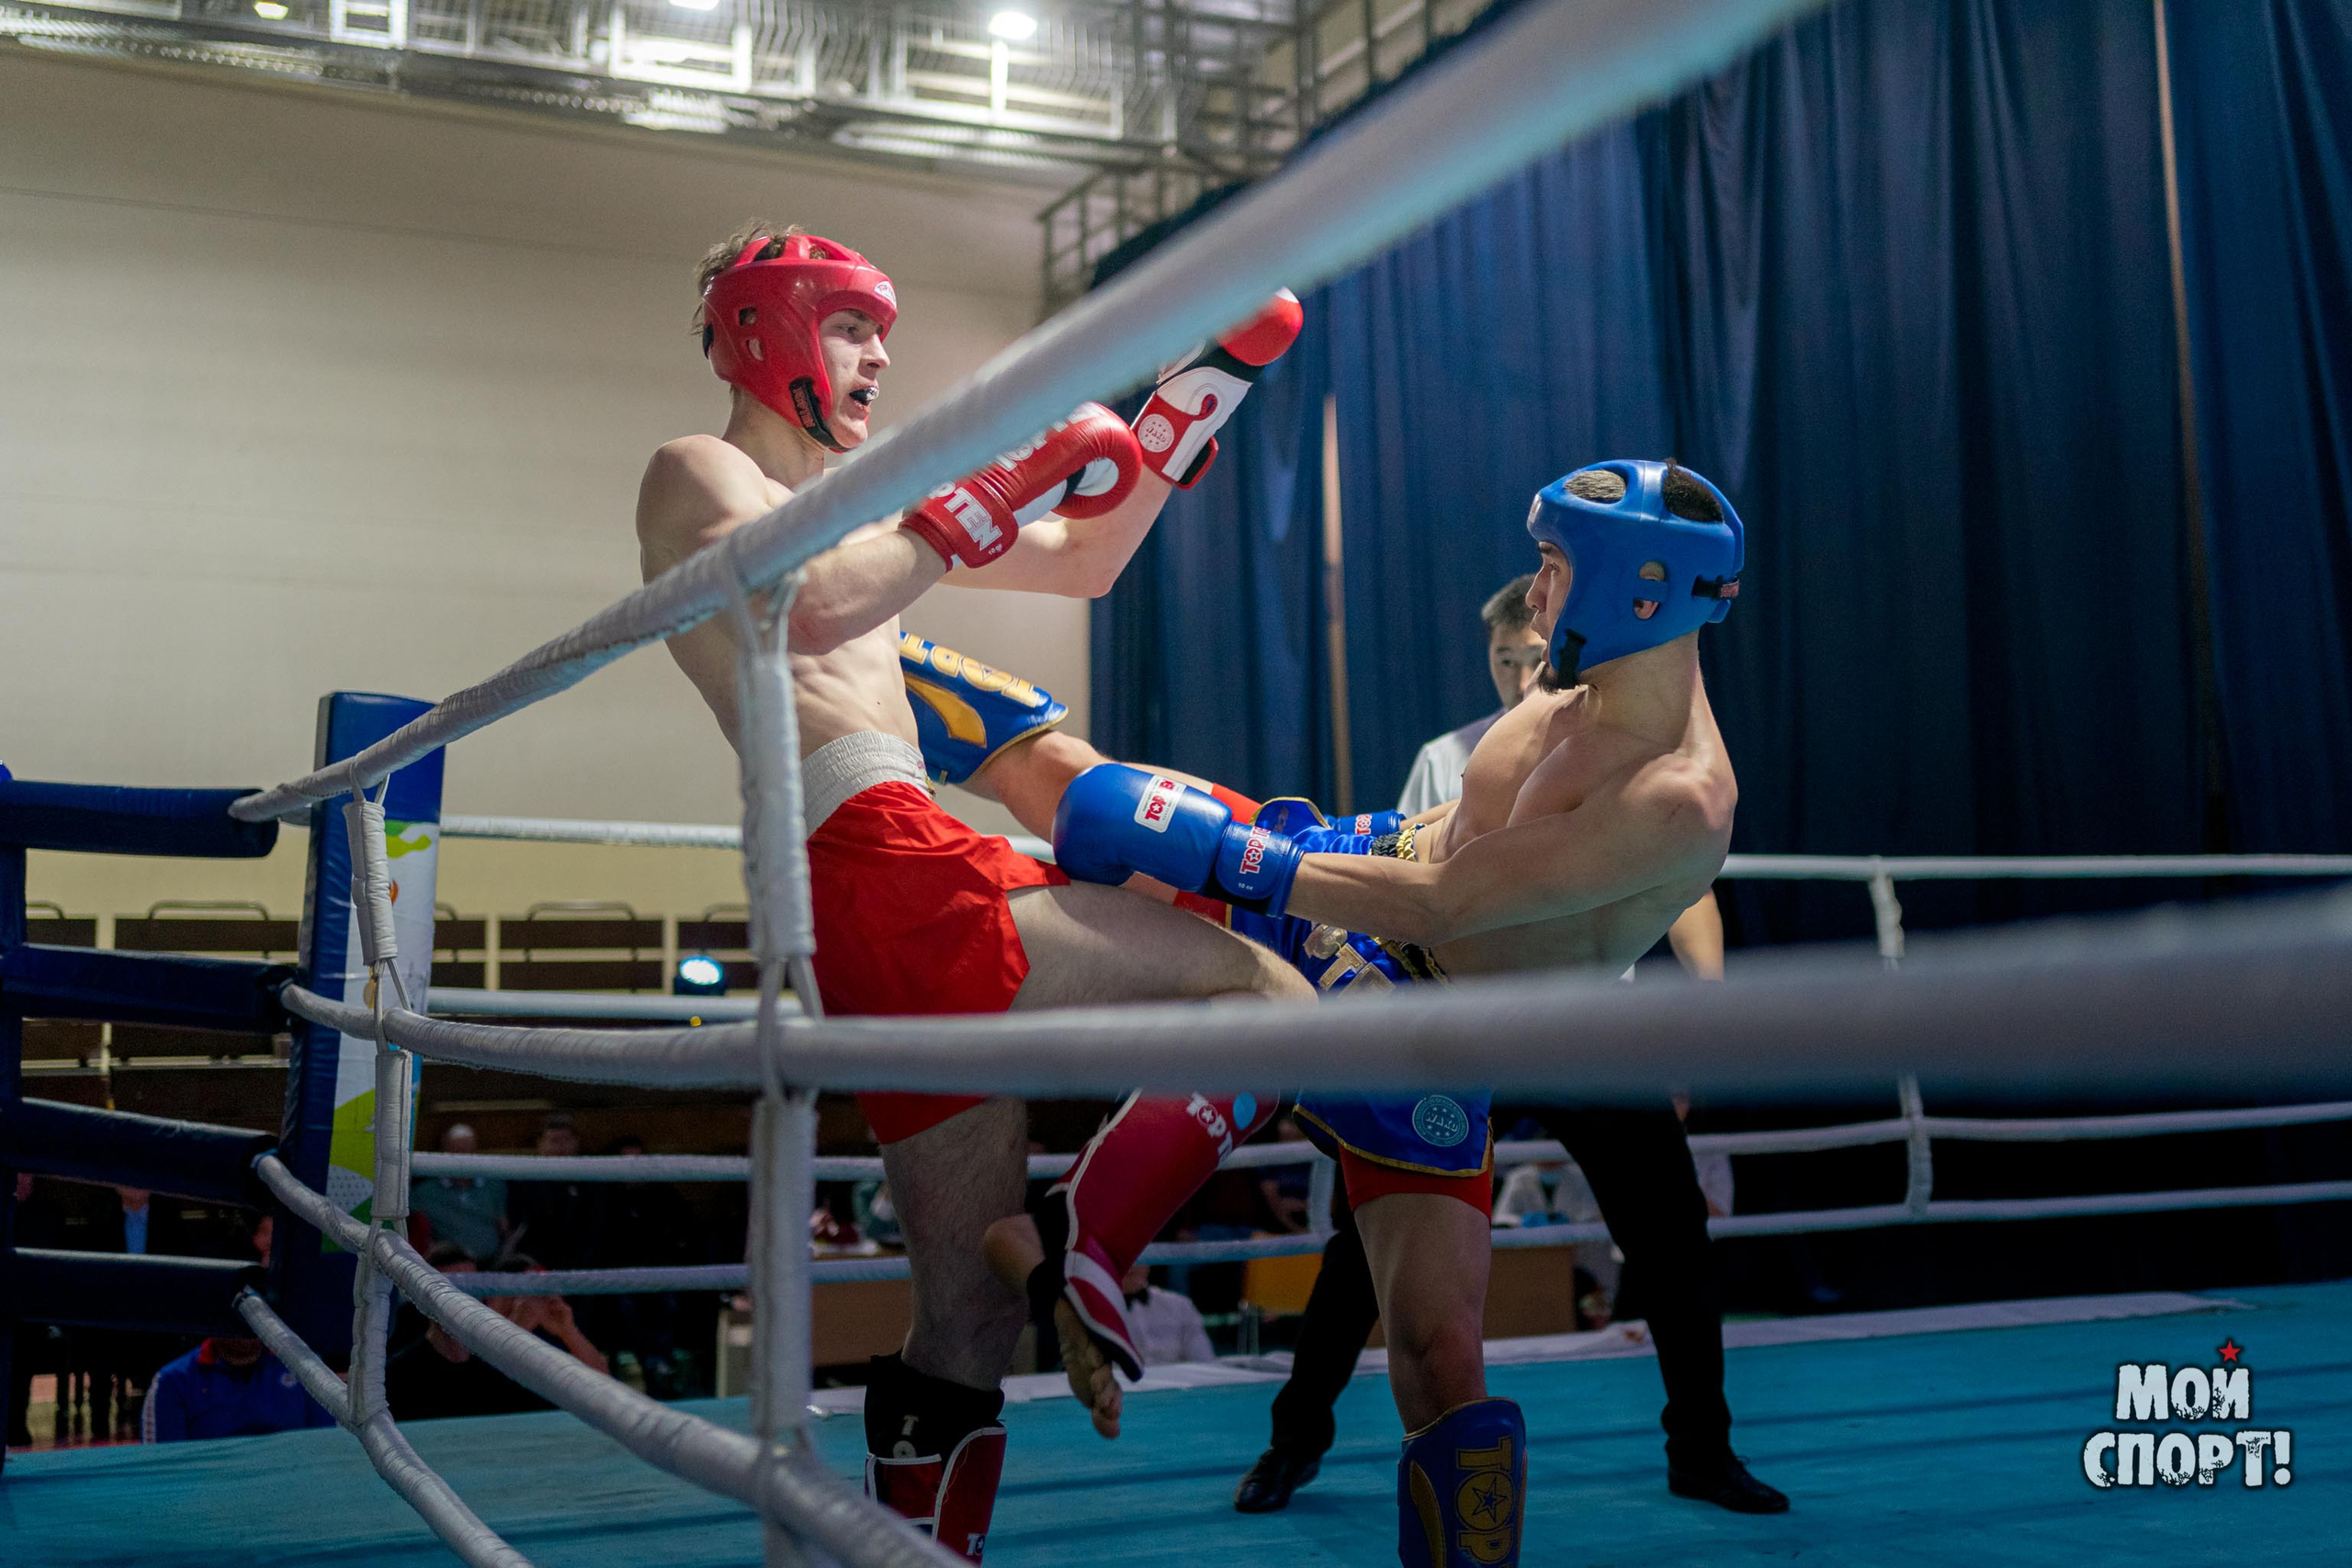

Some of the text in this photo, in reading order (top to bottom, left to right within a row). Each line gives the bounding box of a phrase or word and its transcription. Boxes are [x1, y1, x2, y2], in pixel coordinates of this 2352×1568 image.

[944, 487, 1003, 551] TEN
[1144, 795, 1167, 821] TOP
[1238, 838, 1266, 874] TOP
[1455, 1435, 1516, 1565] TOP
[966, 1532, 986, 1556] TO
